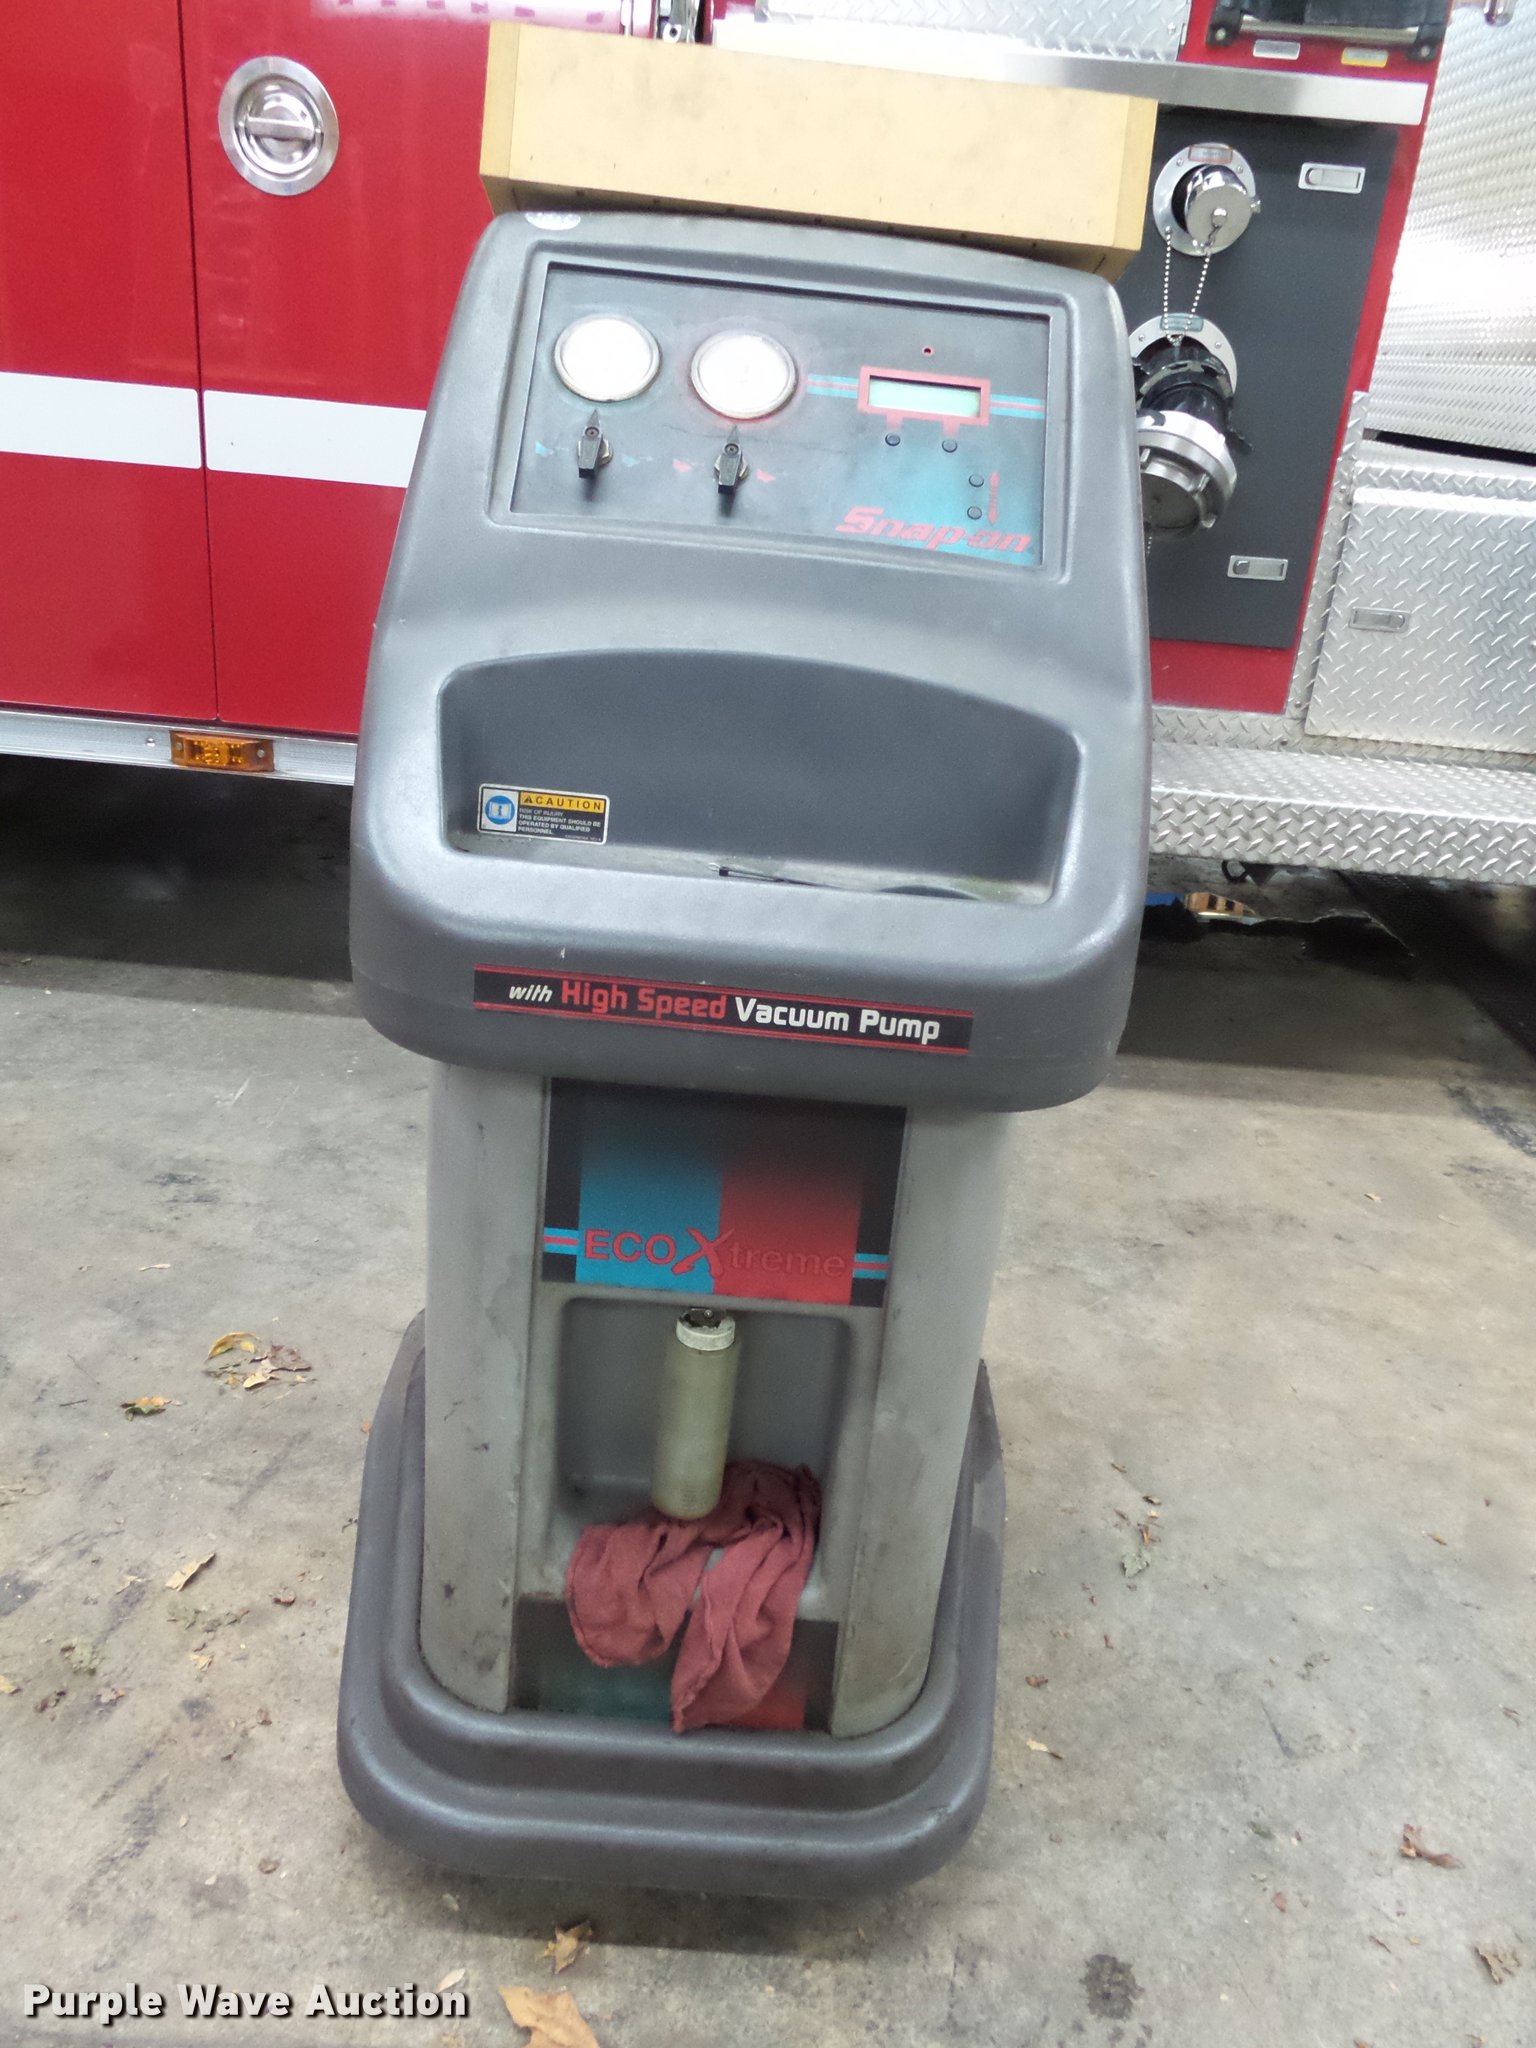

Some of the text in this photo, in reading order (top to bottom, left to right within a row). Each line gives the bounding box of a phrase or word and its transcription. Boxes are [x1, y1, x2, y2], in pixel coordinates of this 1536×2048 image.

[836, 506, 1032, 553] Snap-on
[536, 796, 601, 810] CAUTION
[518, 820, 550, 828] OPERATED
[560, 823, 591, 832] QUALIFIED
[533, 815, 567, 823] EQUIPMENT
[568, 818, 592, 826] SHOULD
[593, 820, 601, 828] BE
[508, 979, 940, 1046] with High Speed Vacuum Pump
